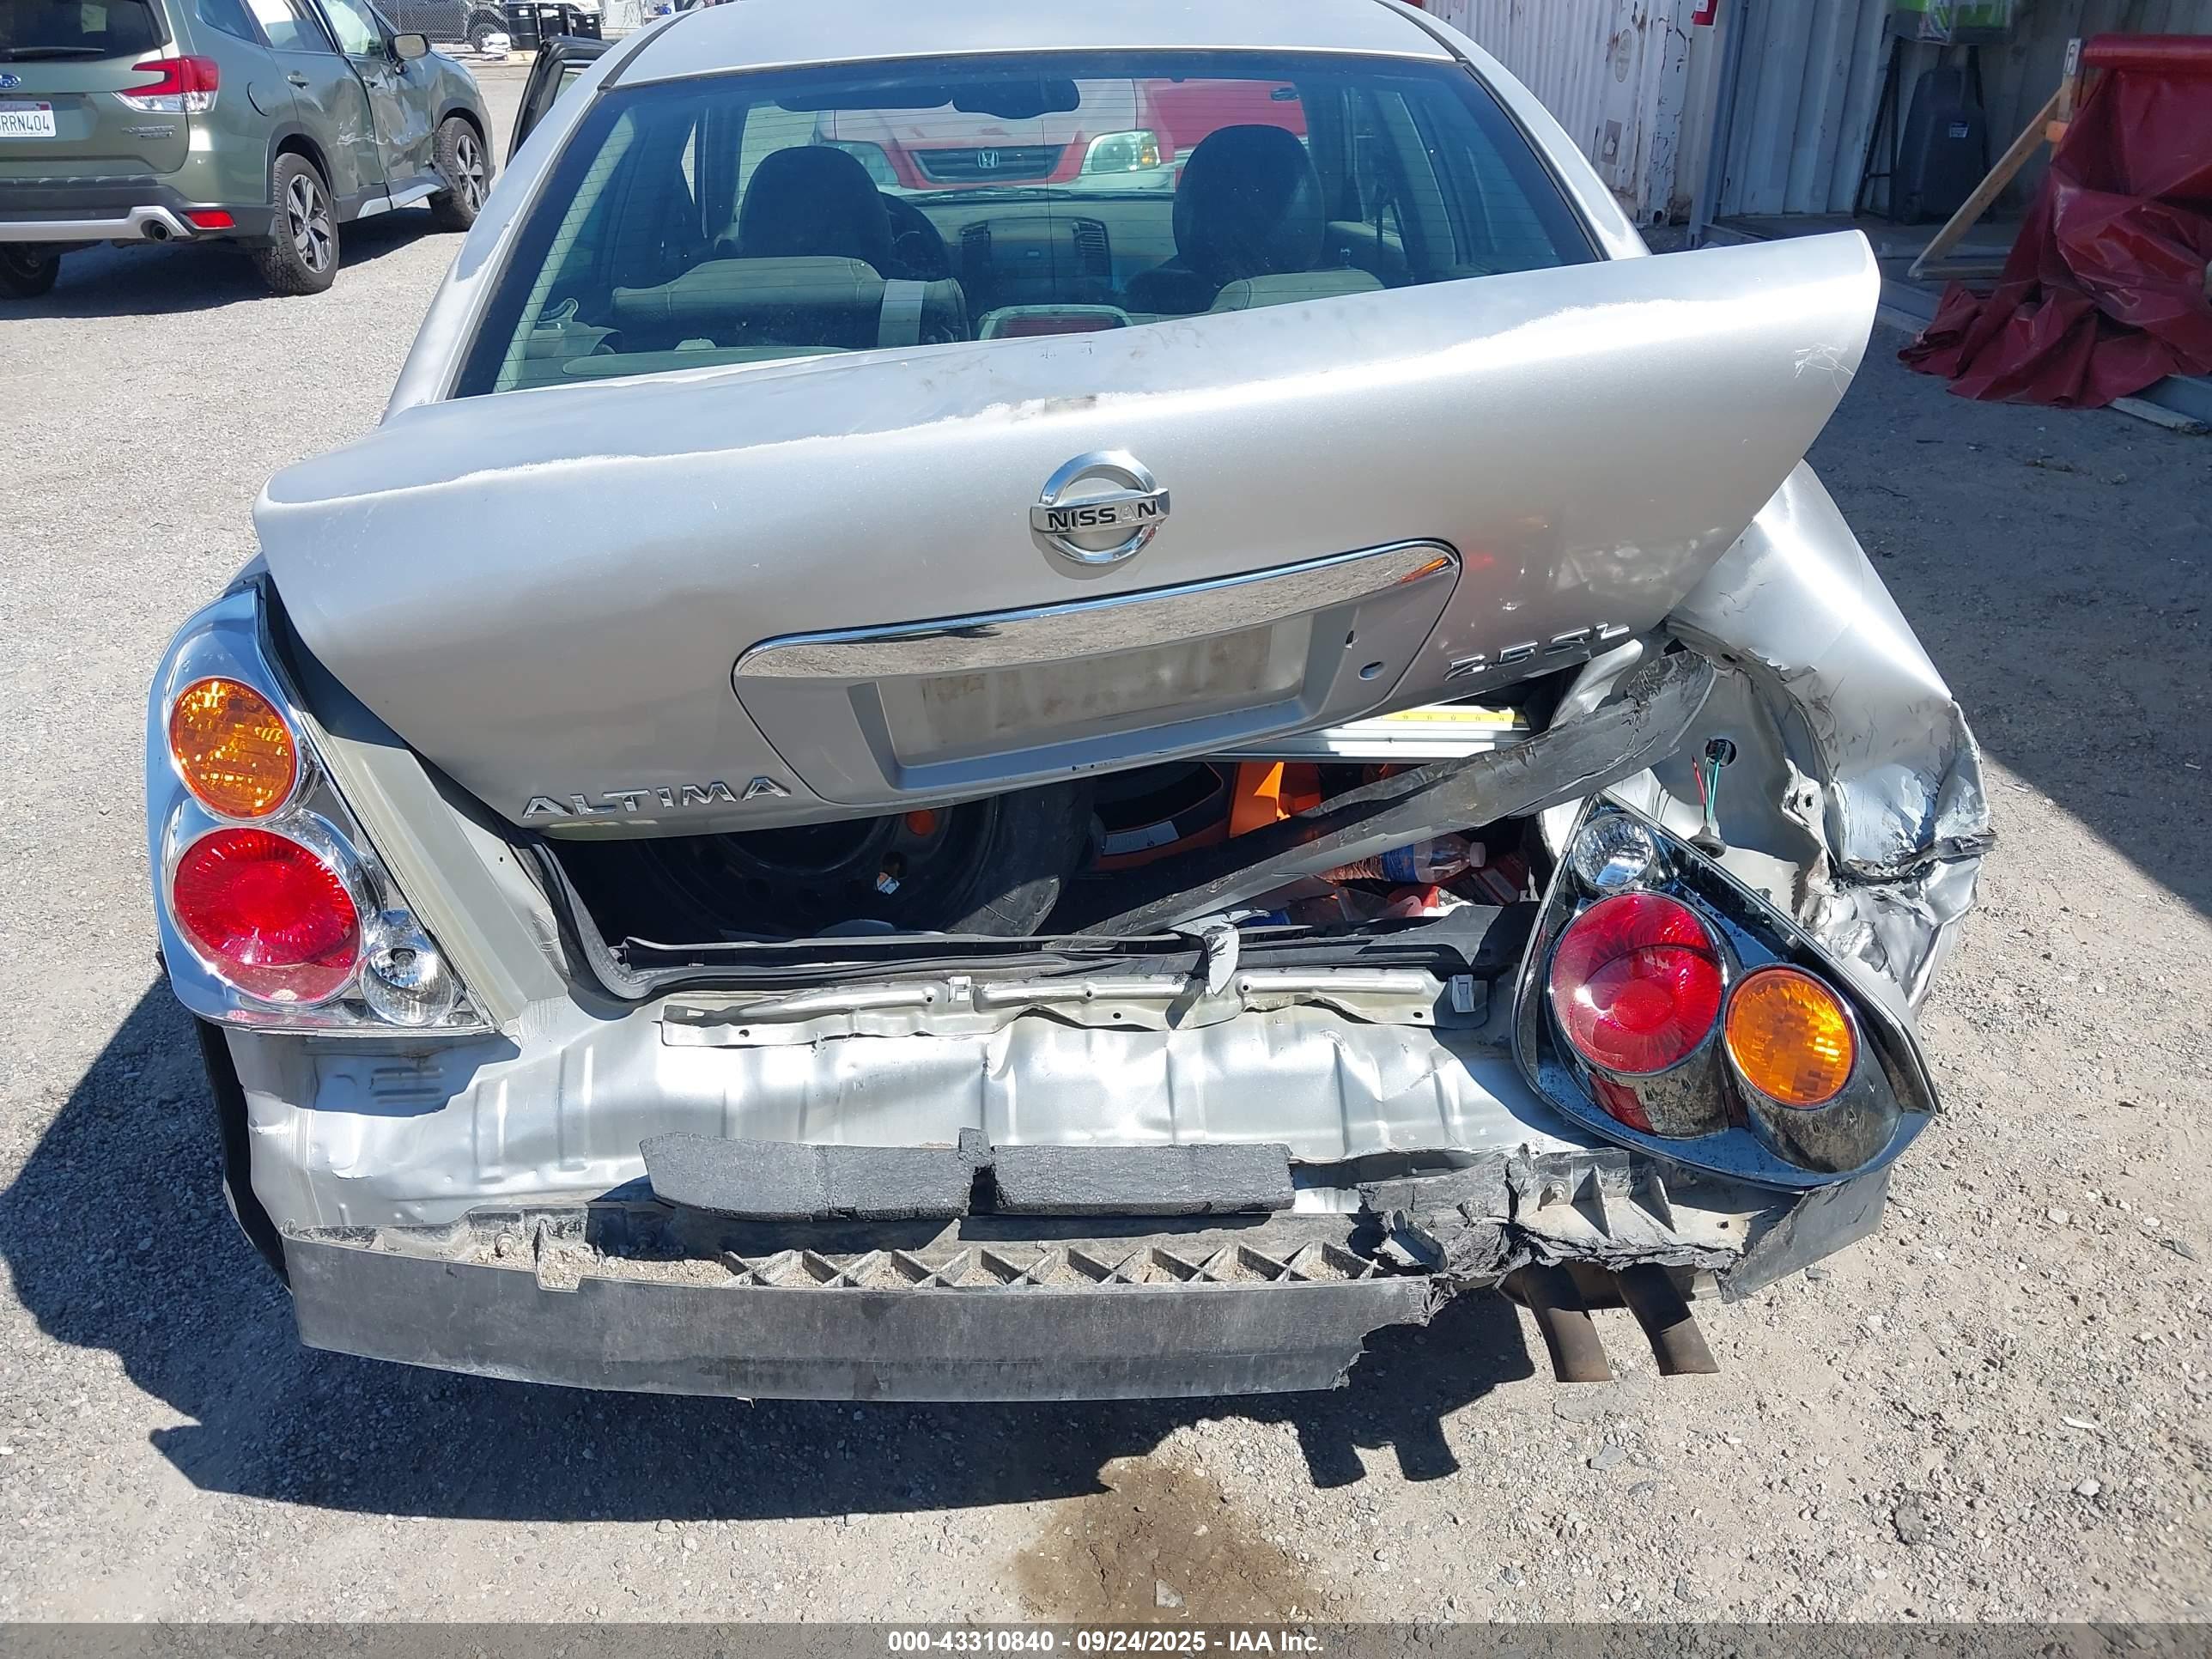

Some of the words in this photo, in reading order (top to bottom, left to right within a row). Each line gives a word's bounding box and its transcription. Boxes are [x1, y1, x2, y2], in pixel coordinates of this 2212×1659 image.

[0, 115, 50, 131] RRN404
[1048, 499, 1157, 531] NISSAN
[521, 775, 792, 819] ALTIMA
